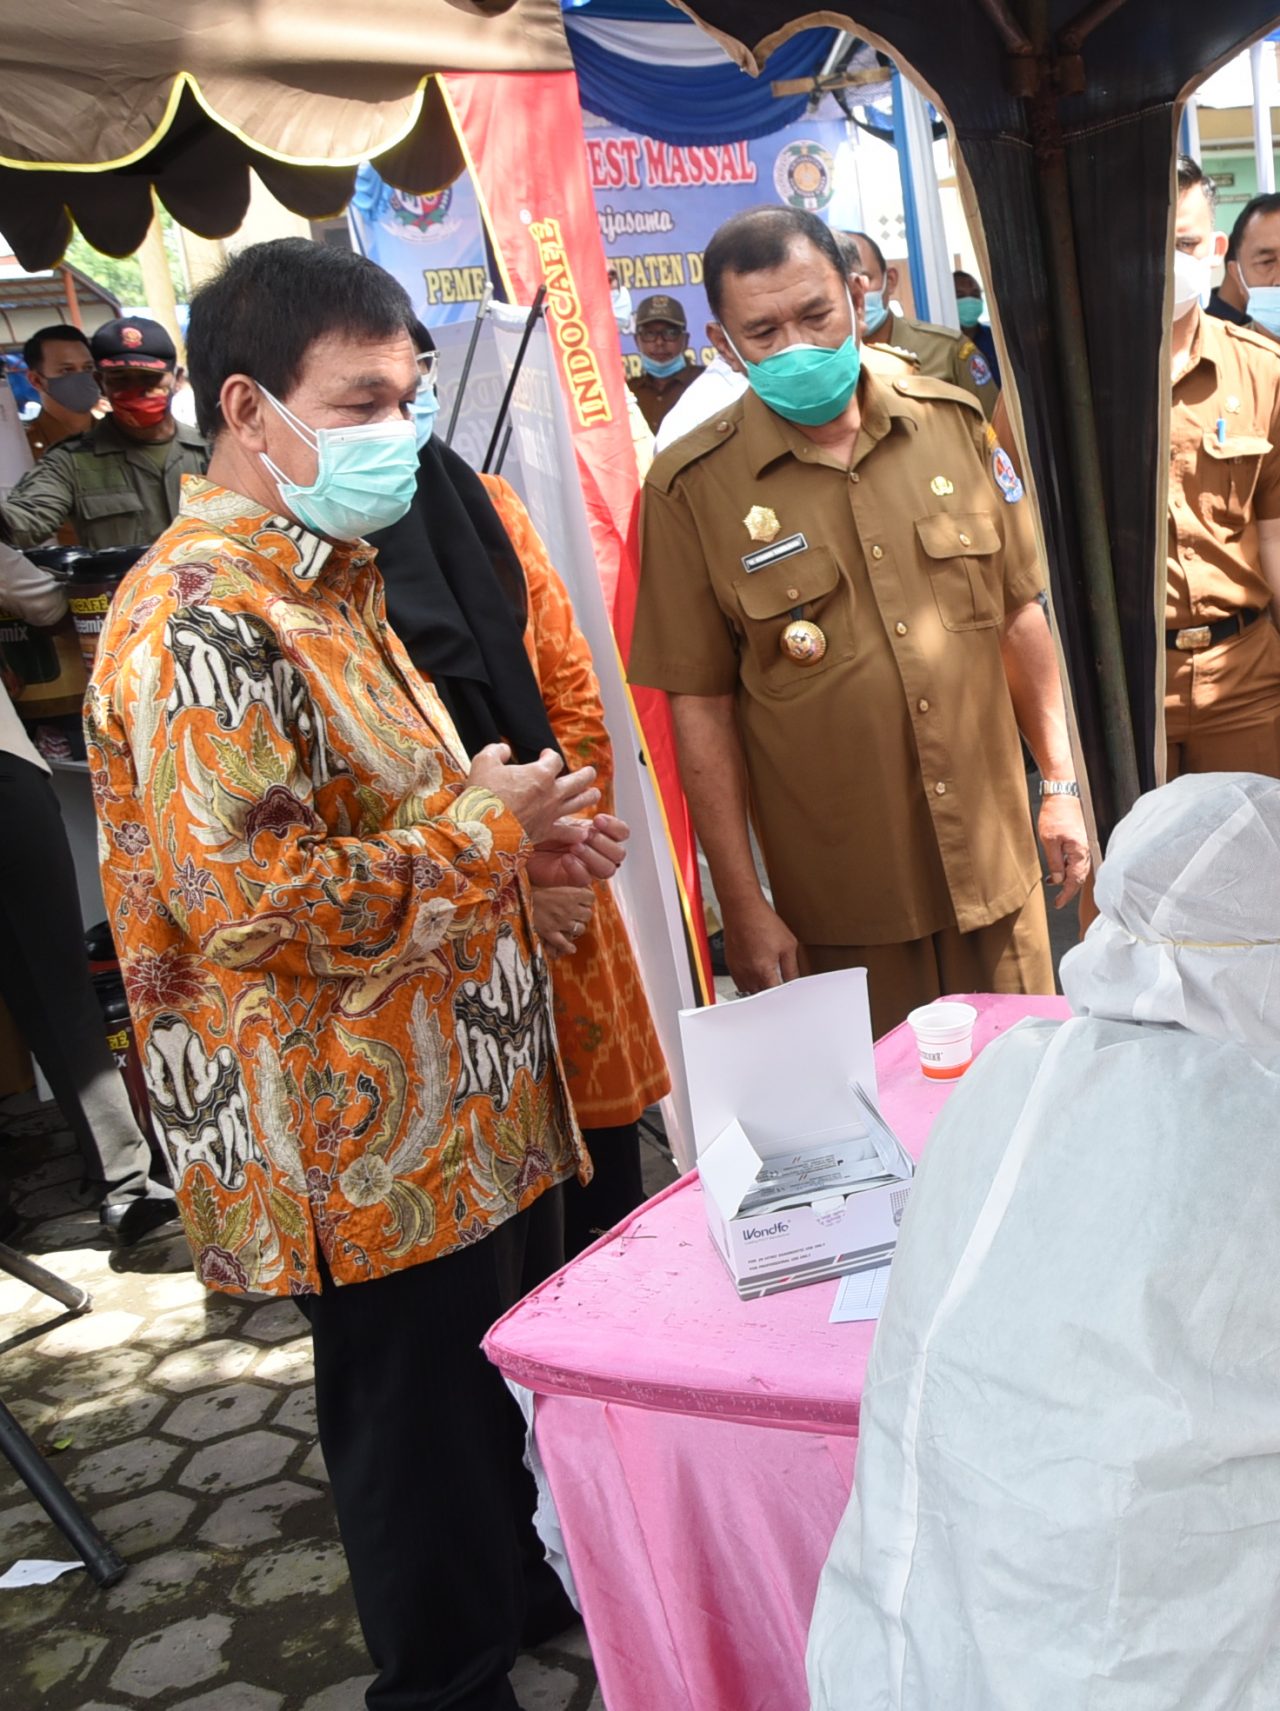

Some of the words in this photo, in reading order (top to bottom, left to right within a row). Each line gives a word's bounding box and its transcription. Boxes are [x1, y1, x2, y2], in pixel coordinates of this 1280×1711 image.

[584, 136, 640, 187] EST
[641, 135, 756, 187] MASSAL
[742, 1220, 789, 1241] Wondfo
